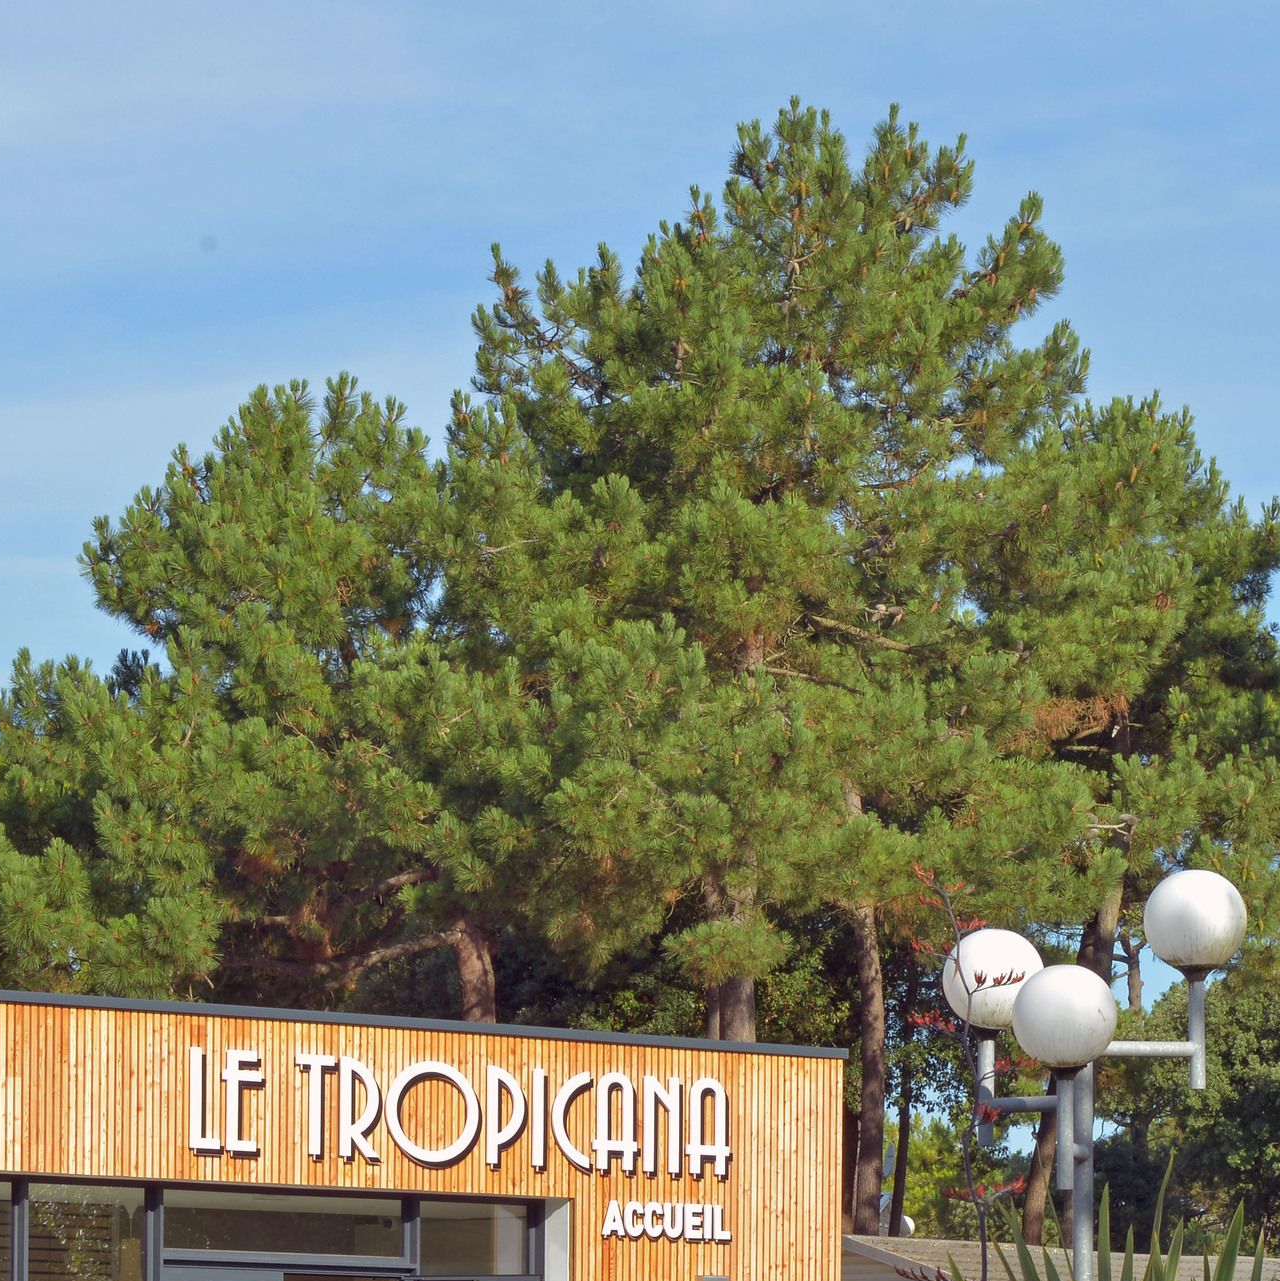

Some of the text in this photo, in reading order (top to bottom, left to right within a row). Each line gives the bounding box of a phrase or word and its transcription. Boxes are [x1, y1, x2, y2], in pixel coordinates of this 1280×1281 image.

[189, 1046, 731, 1180] LE TROPICANA
[601, 1200, 732, 1243] ACCUEIL
